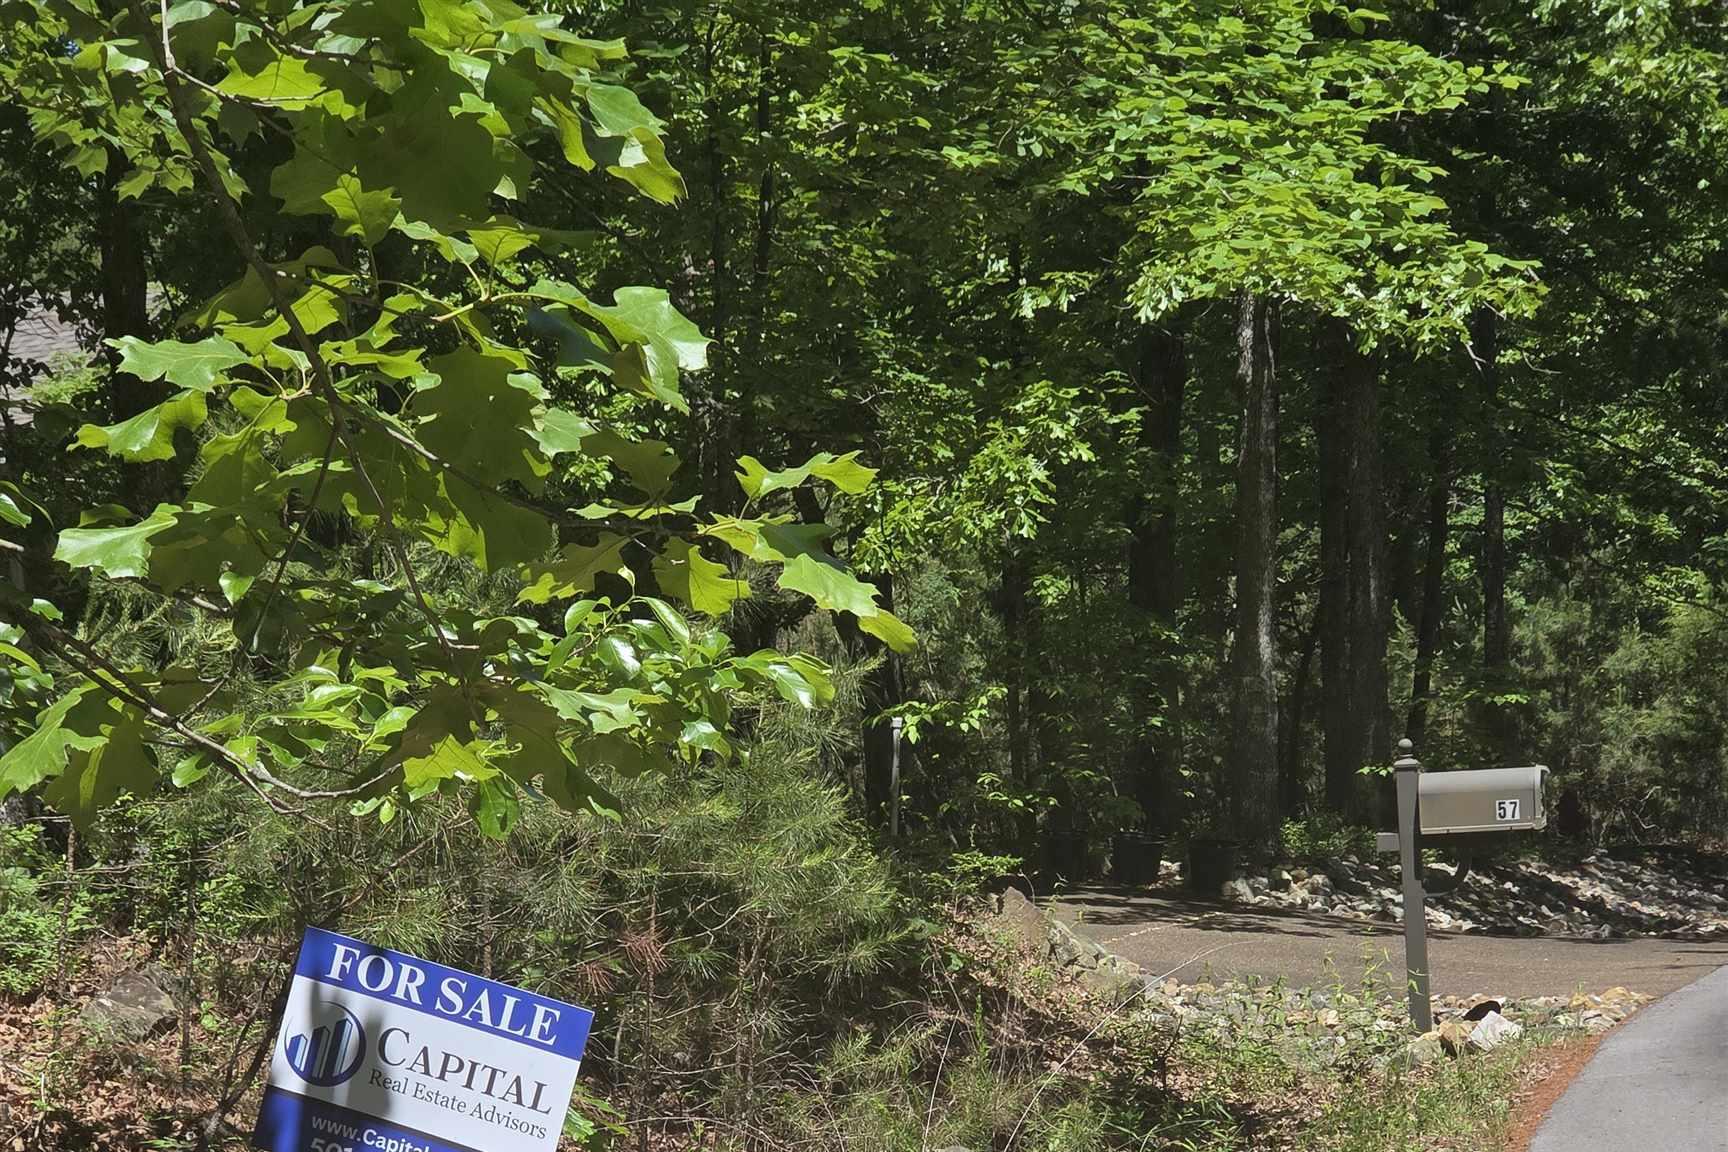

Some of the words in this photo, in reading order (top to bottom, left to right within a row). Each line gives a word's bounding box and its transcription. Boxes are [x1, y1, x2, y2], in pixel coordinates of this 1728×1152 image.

[1498, 801, 1517, 819] 57
[325, 943, 426, 1006] FOR
[434, 976, 561, 1046] SALE
[368, 1069, 408, 1095] Real
[413, 1084, 467, 1113] Estate
[470, 1102, 548, 1140] Advisors
[378, 1027, 553, 1115] CAPITAL
